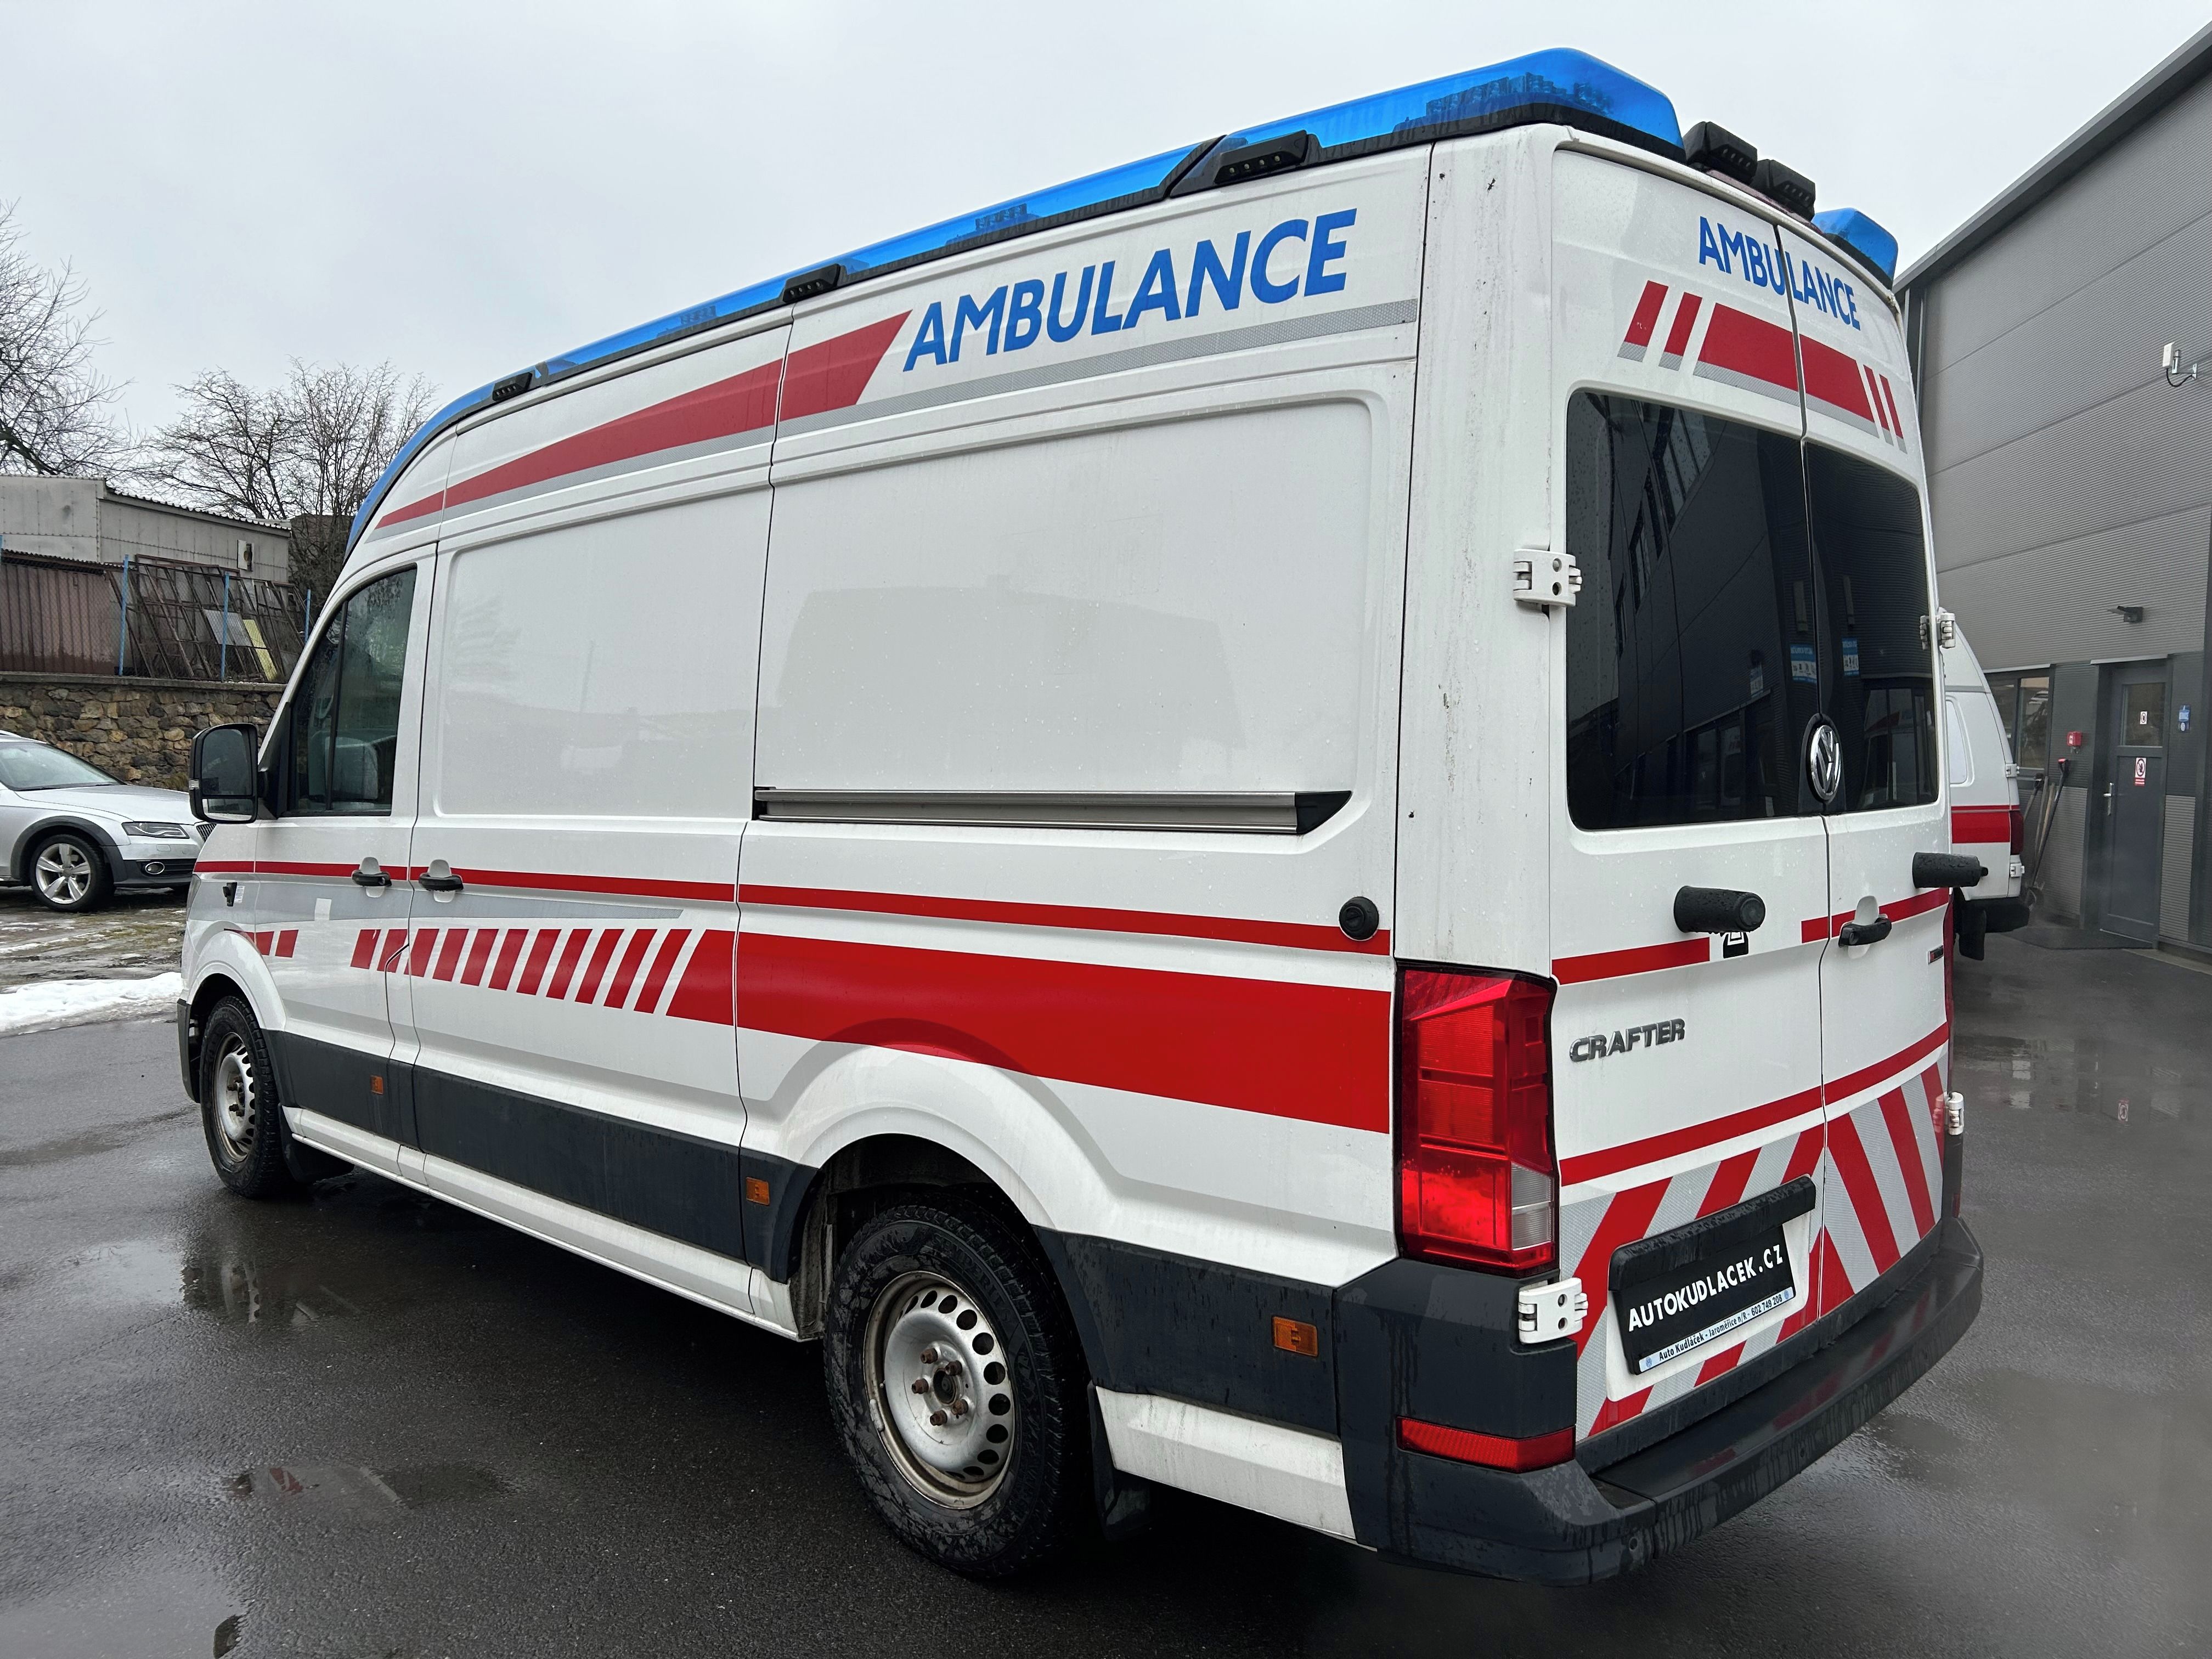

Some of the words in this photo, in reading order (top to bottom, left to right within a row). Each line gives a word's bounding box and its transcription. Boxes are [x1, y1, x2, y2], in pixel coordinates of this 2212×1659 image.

[902, 208, 1357, 372] AMBULANCE
[1700, 216, 1861, 331] AMBULANCE
[1570, 1018, 1685, 1062] CRAFTER
[1628, 1244, 1783, 1332] AUTOKUDLACEK.CZ
[1658, 1347, 1674, 1361] Auto
[1675, 1333, 1705, 1352] Kudláček
[1708, 1318, 1737, 1337] Jaroměřice
[1751, 1305, 1762, 1316] 602
[1762, 1300, 1772, 1311] 749
[1773, 1294, 1782, 1306] 208
